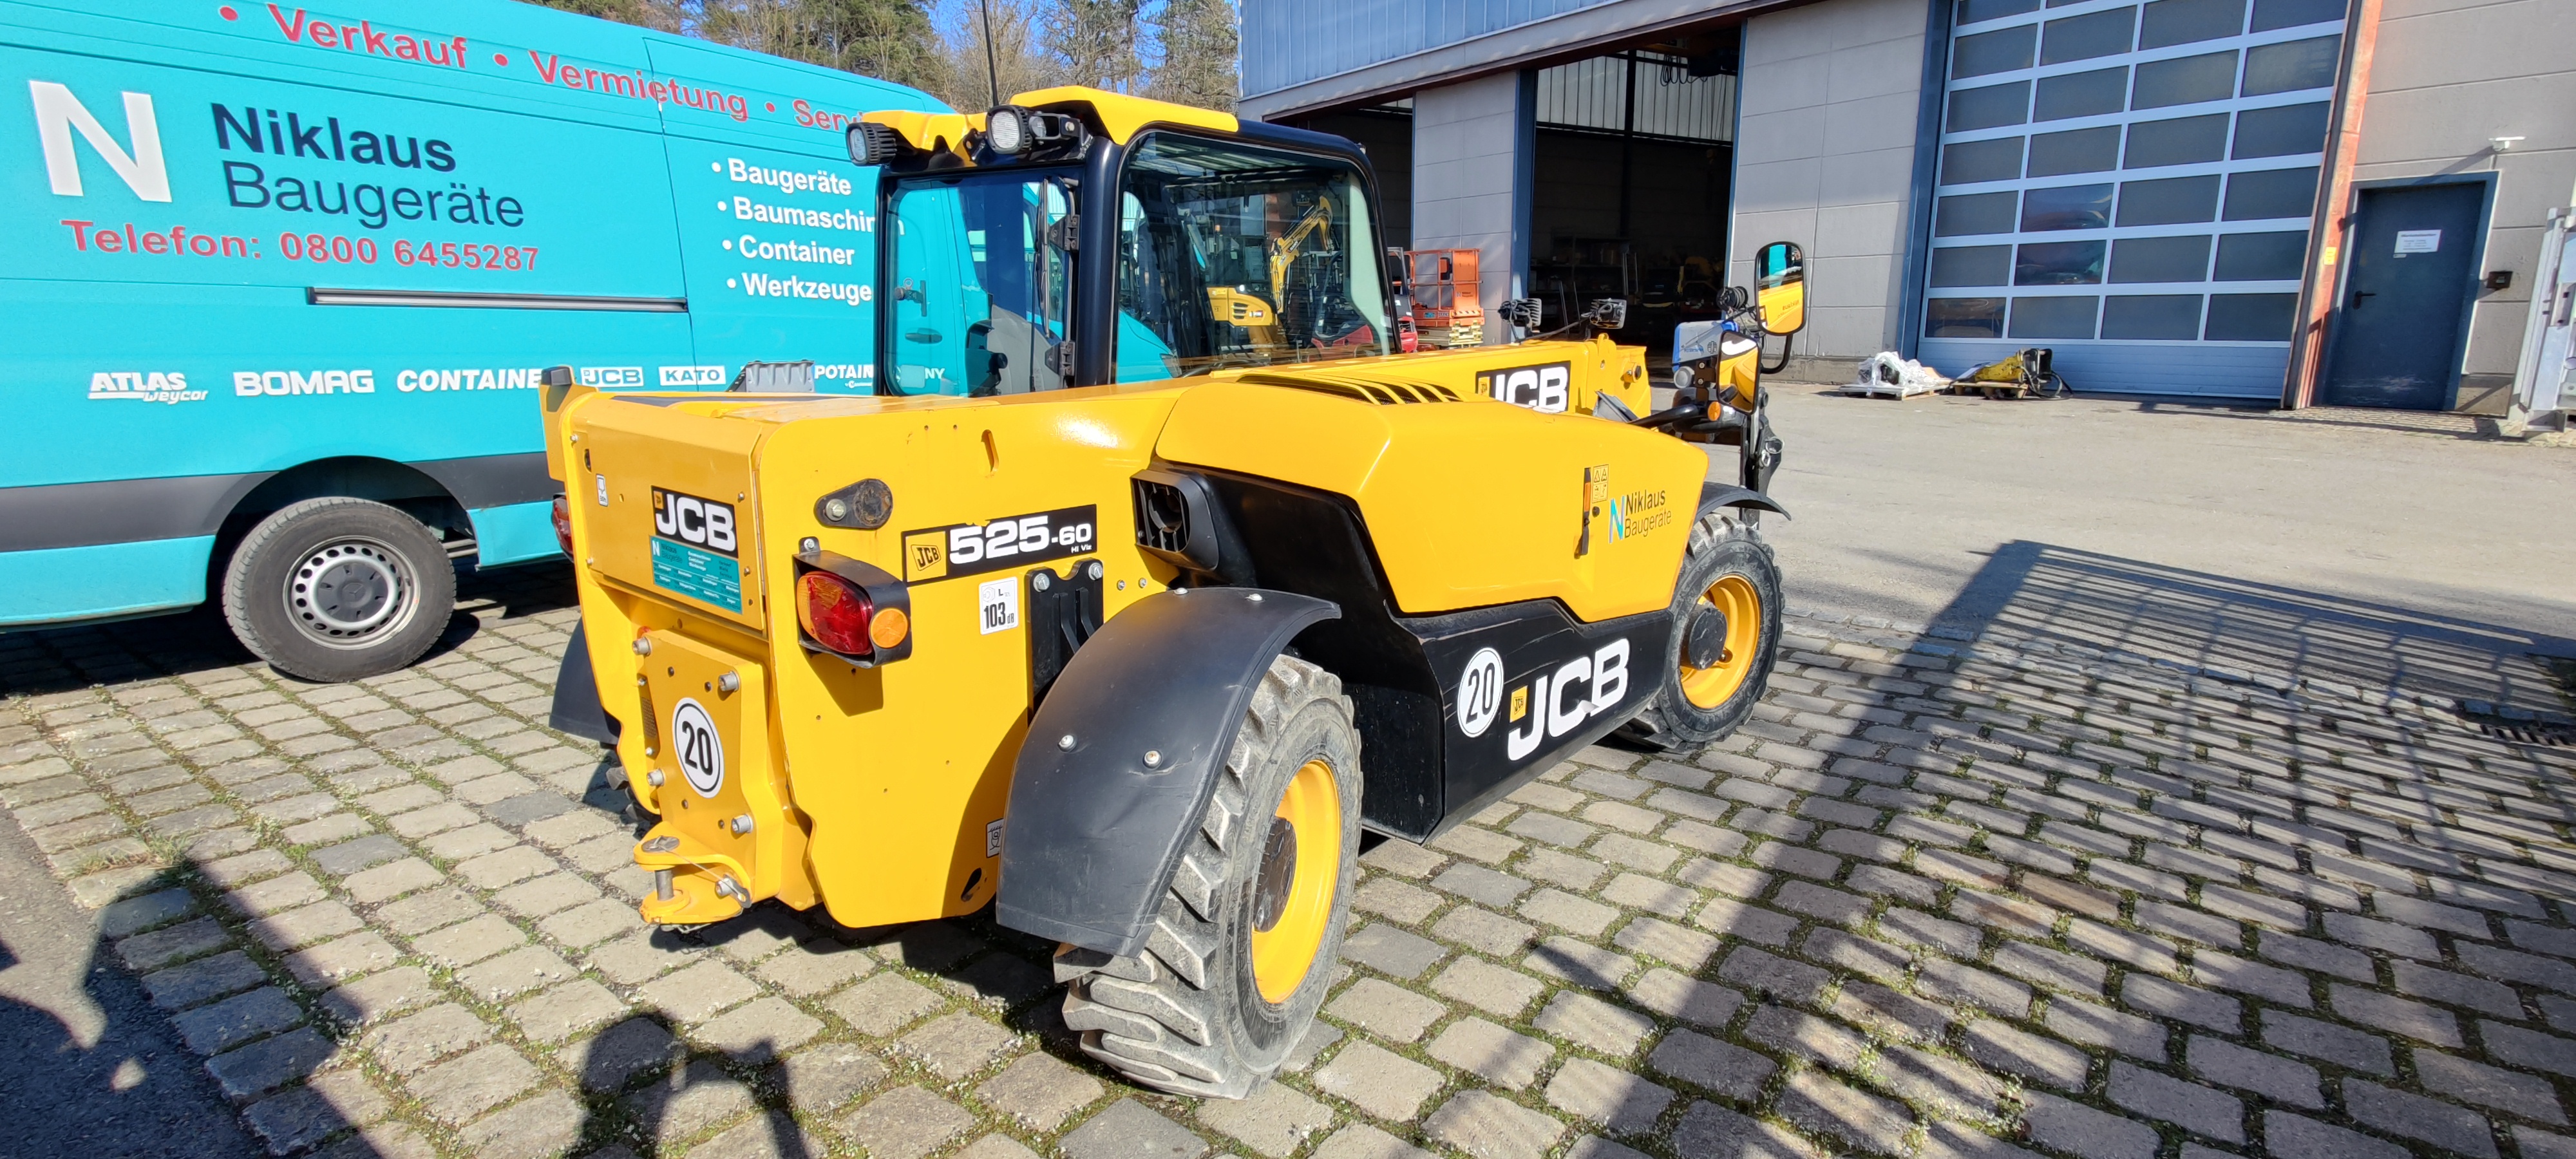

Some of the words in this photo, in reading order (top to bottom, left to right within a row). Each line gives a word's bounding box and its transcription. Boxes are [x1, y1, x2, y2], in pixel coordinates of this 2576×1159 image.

[267, 3, 467, 69] Verkauf
[529, 50, 749, 122] Vermietung
[28, 80, 172, 202] N
[211, 103, 456, 172] Niklaus
[728, 158, 851, 195] Baugeräte
[222, 161, 524, 230] Baugeräte
[61, 219, 261, 259] Telefon:
[279, 232, 377, 264] 0800
[393, 240, 538, 272] 6455287
[739, 235, 855, 265] Container
[742, 273, 872, 305] Werkzeuge
[91, 372, 187, 391] ATLAS
[233, 370, 375, 396] BOMAG
[397, 369, 542, 391] CONTAINE
[585, 369, 641, 385] JCB
[665, 369, 720, 382] KATO
[814, 364, 874, 379] POTAIN
[143, 390, 208, 404] weycor
[1626, 489, 1665, 516] Niklaus
[656, 493, 735, 551] JCB
[1625, 507, 1671, 538] Baugeräte
[949, 515, 1092, 564] 525-60
[917, 546, 940, 568] JCB
[983, 601, 1006, 629] 103
[1007, 612, 1014, 624] dB
[1466, 659, 1497, 726] 20
[1508, 637, 1631, 762] JCB
[681, 720, 713, 777] 20
